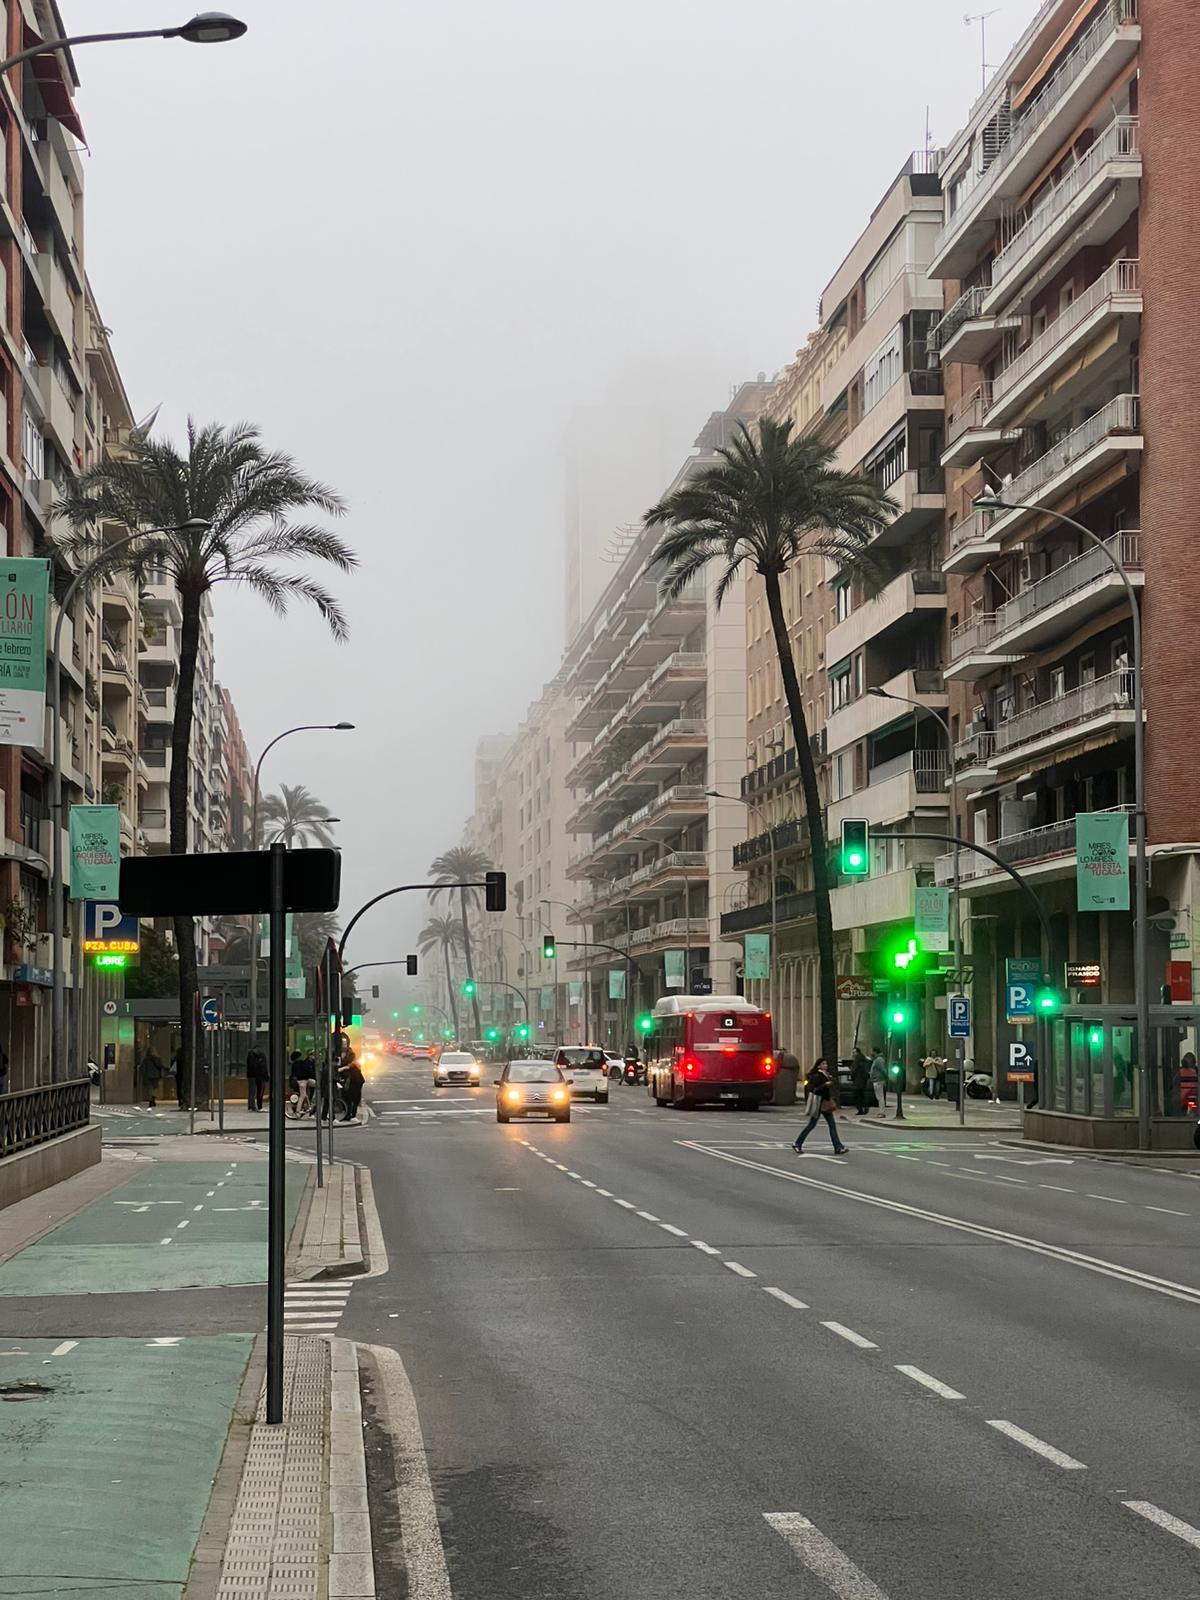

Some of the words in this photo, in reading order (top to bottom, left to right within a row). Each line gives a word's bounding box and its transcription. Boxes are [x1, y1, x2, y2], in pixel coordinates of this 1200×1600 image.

[0, 587, 33, 620] ÓN
[4, 642, 32, 656] febrero
[95, 904, 122, 939] P
[109, 941, 138, 950] CUBA
[96, 955, 125, 966] LIBRE
[1010, 986, 1027, 1009] P
[125, 1002, 130, 1013] 1
[955, 1002, 966, 1019] P
[1010, 1043, 1027, 1066] P
